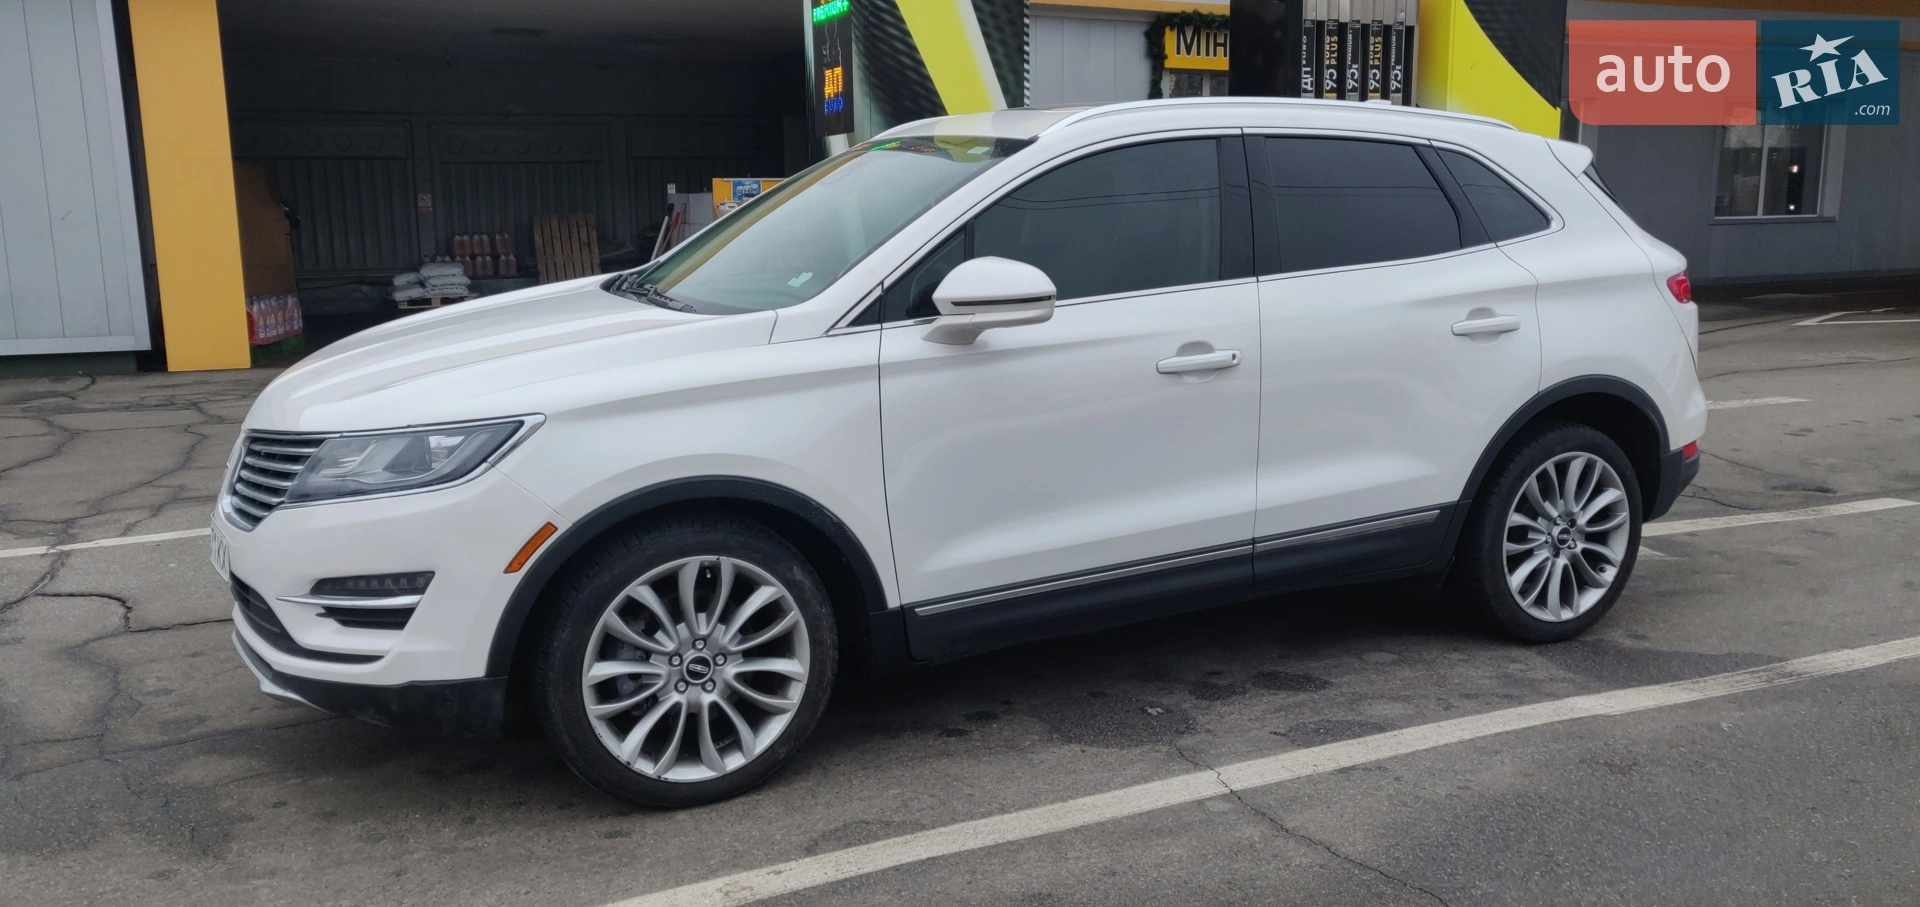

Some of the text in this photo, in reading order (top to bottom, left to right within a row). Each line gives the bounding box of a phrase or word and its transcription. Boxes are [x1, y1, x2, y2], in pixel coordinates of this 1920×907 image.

[1330, 35, 1338, 65] PLUS
[1373, 36, 1382, 65] PLUS
[1325, 68, 1338, 90] 95
[1369, 68, 1380, 90] 95
[824, 96, 843, 115] EURO
